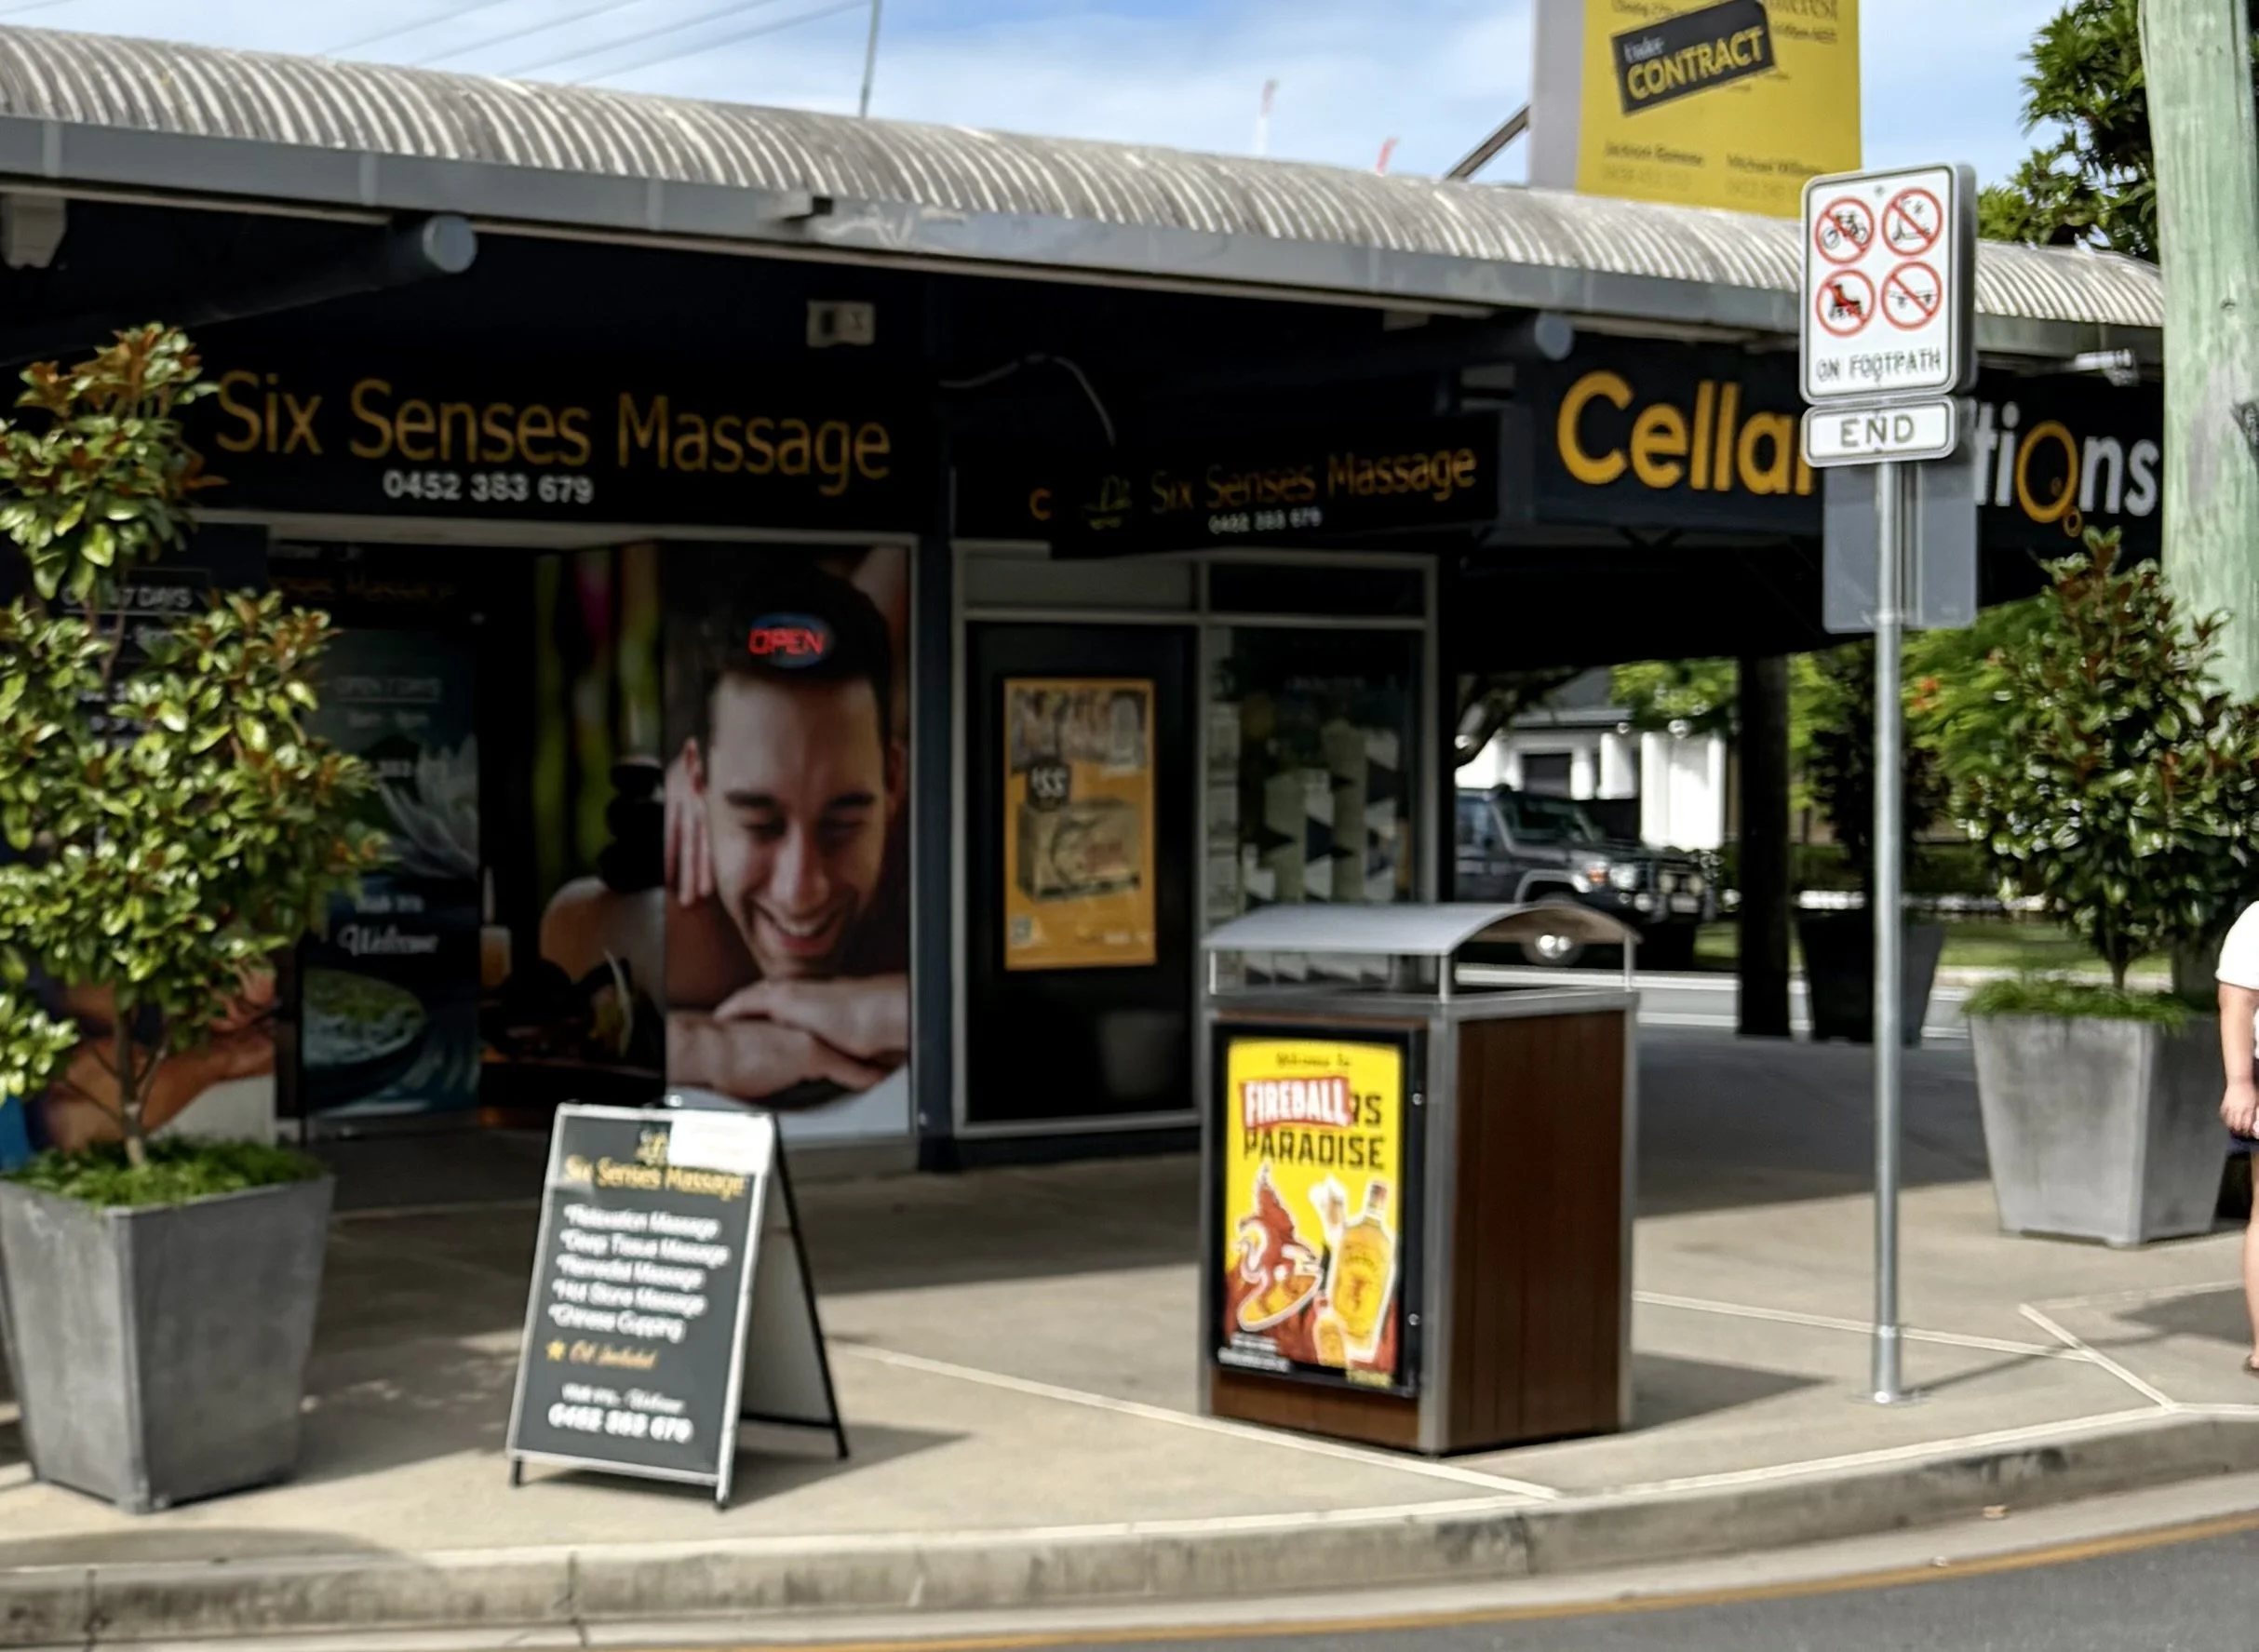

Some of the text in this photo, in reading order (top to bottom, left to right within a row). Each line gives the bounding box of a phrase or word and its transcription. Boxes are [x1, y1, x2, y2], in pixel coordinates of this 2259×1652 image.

[1627, 27, 1766, 101] CONTRACT
[1816, 348, 1942, 382] ON FOOTPATH
[215, 371, 892, 497] Six Senses Massage
[1839, 413, 1916, 448] END
[382, 467, 597, 505] 0452 383 679
[1150, 447, 1478, 516] Six Senses Massage
[748, 628, 827, 654] OPEN
[1244, 1077, 1349, 1129] FIREBALL
[1244, 1128, 1385, 1170] PARADISE
[597, 1157, 662, 1190] Senses
[665, 1165, 746, 1202] Massage
